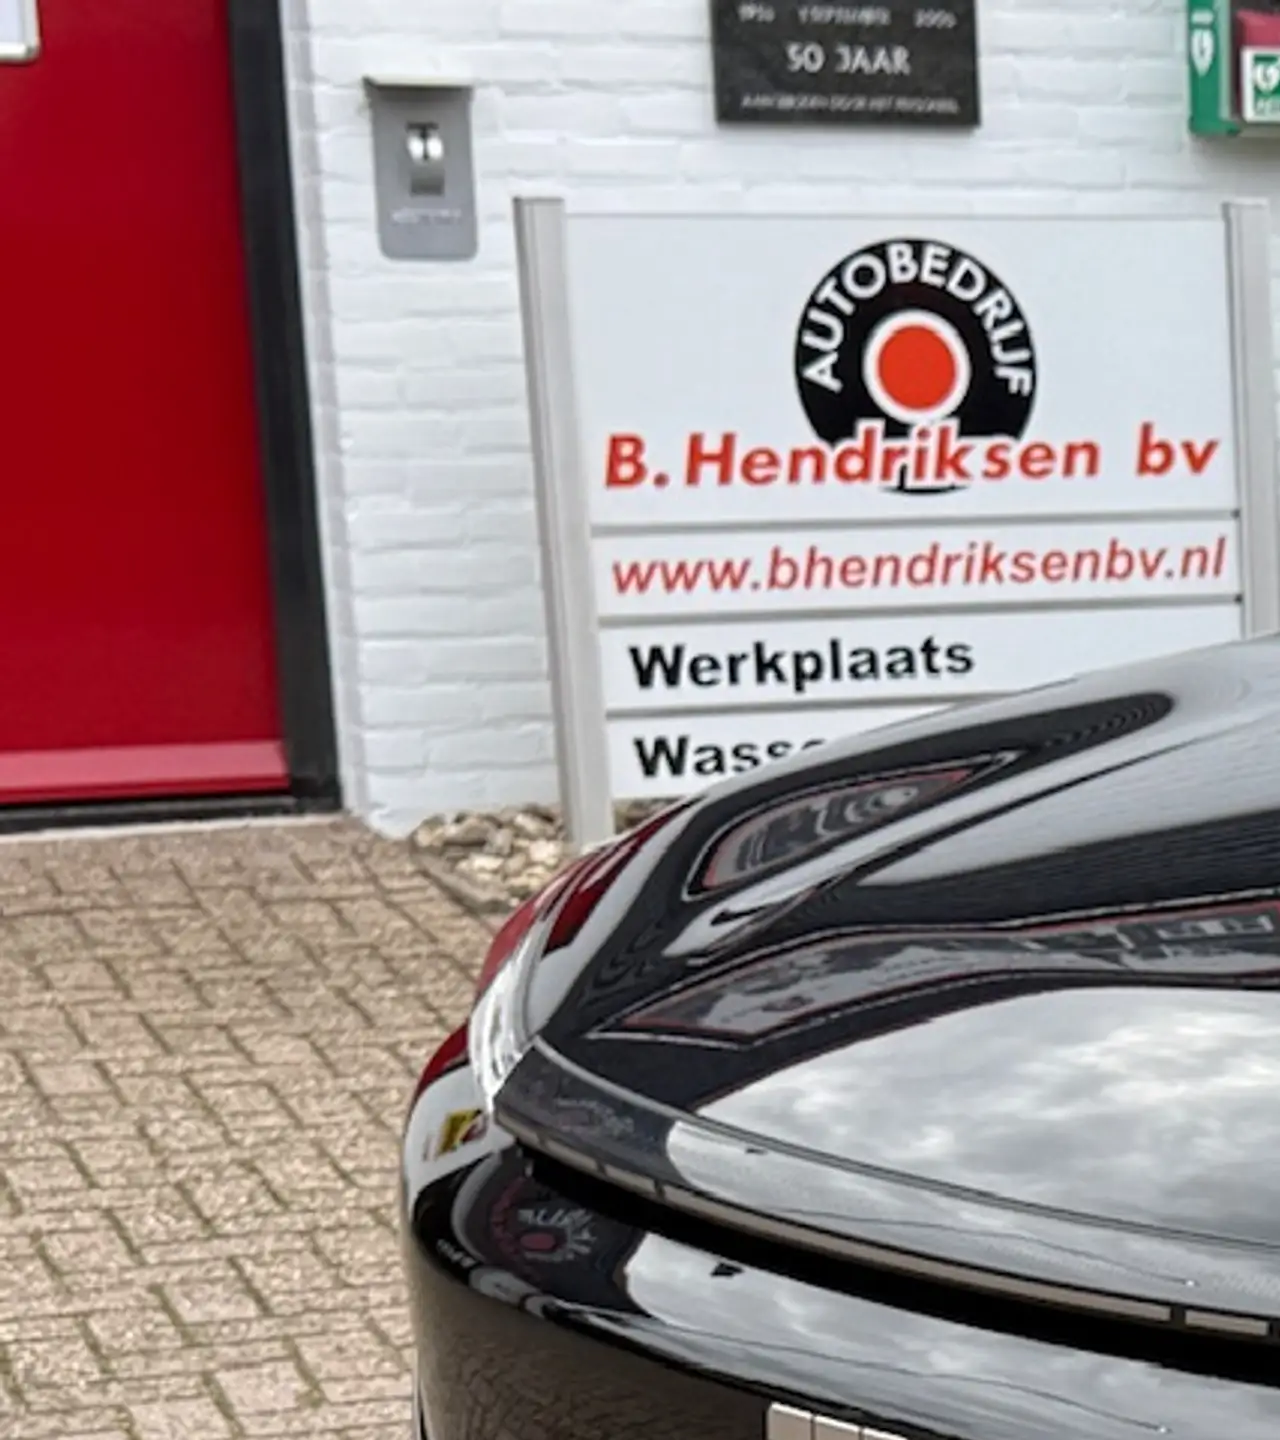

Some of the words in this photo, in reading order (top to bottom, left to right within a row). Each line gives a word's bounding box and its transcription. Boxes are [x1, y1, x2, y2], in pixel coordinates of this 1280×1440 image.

[834, 43, 911, 76] JAAR
[801, 242, 1033, 397] AUTOBEDRIJF
[604, 432, 669, 490] B.
[684, 420, 1102, 487] Hendriksen
[1135, 422, 1220, 477] bv
[612, 536, 1227, 595] www.bhendriksenbv.nl
[628, 634, 976, 694] Werkplaats
